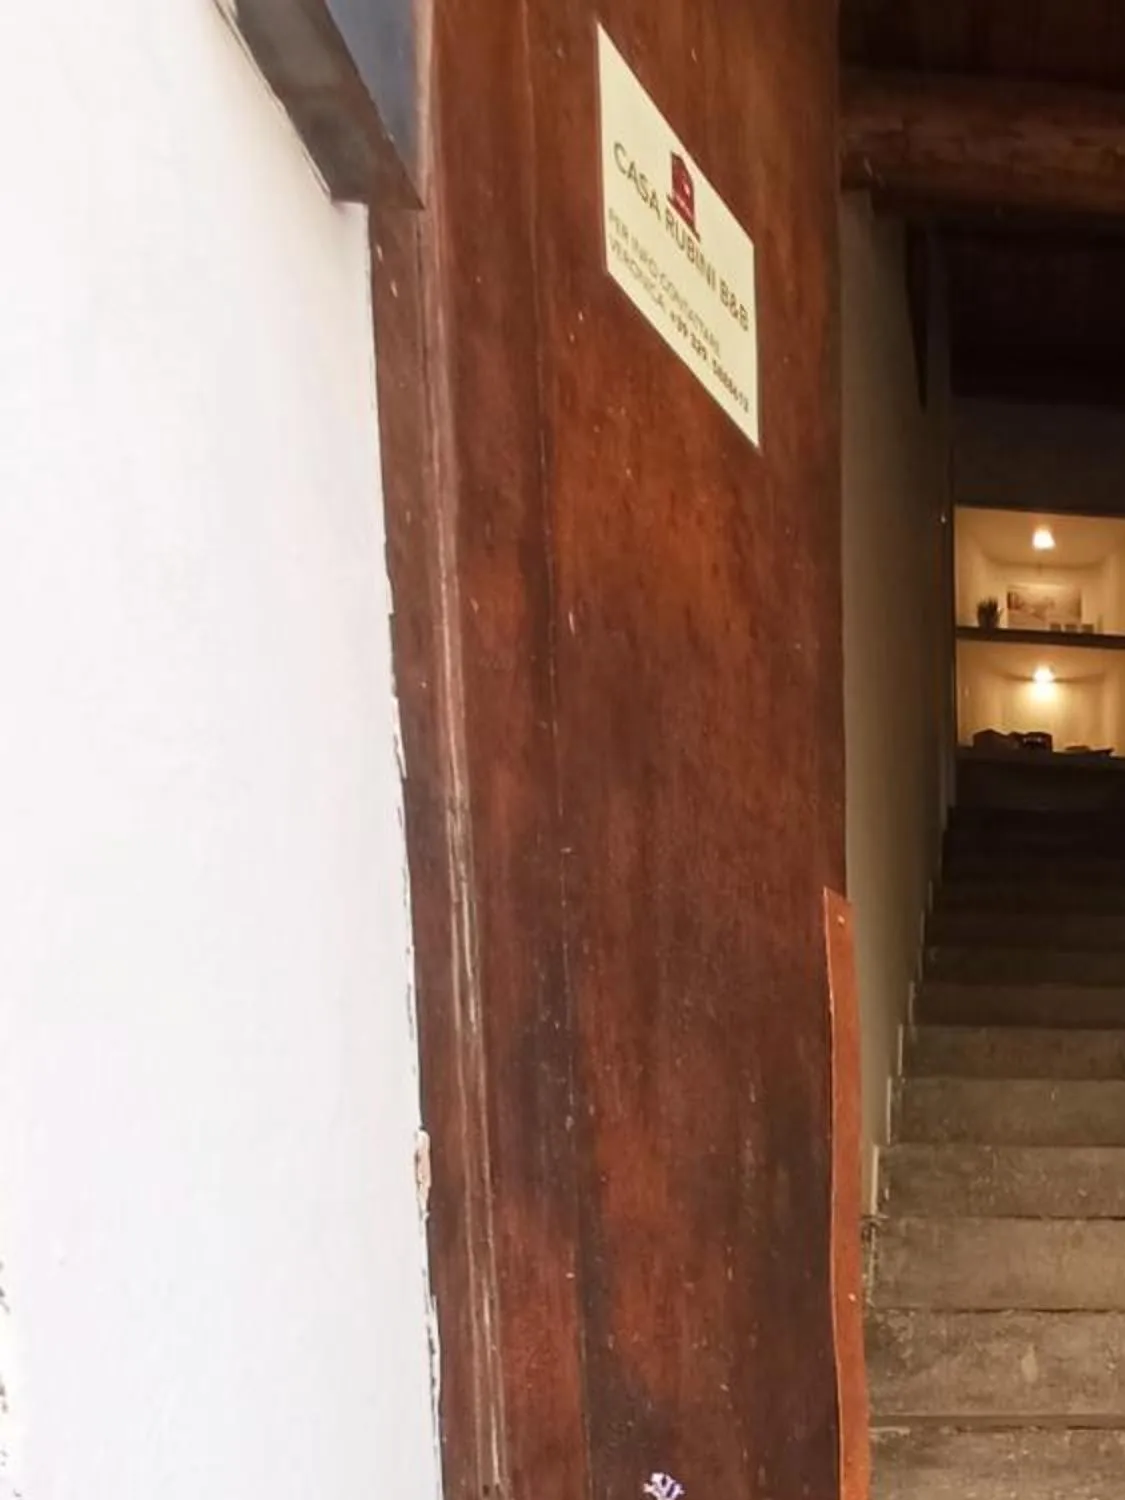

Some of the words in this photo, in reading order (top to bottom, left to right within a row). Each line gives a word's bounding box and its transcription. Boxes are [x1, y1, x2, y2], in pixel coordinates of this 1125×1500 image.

[613, 142, 661, 220] CASA
[665, 207, 716, 292] RUBINI
[719, 276, 749, 332] B&B
